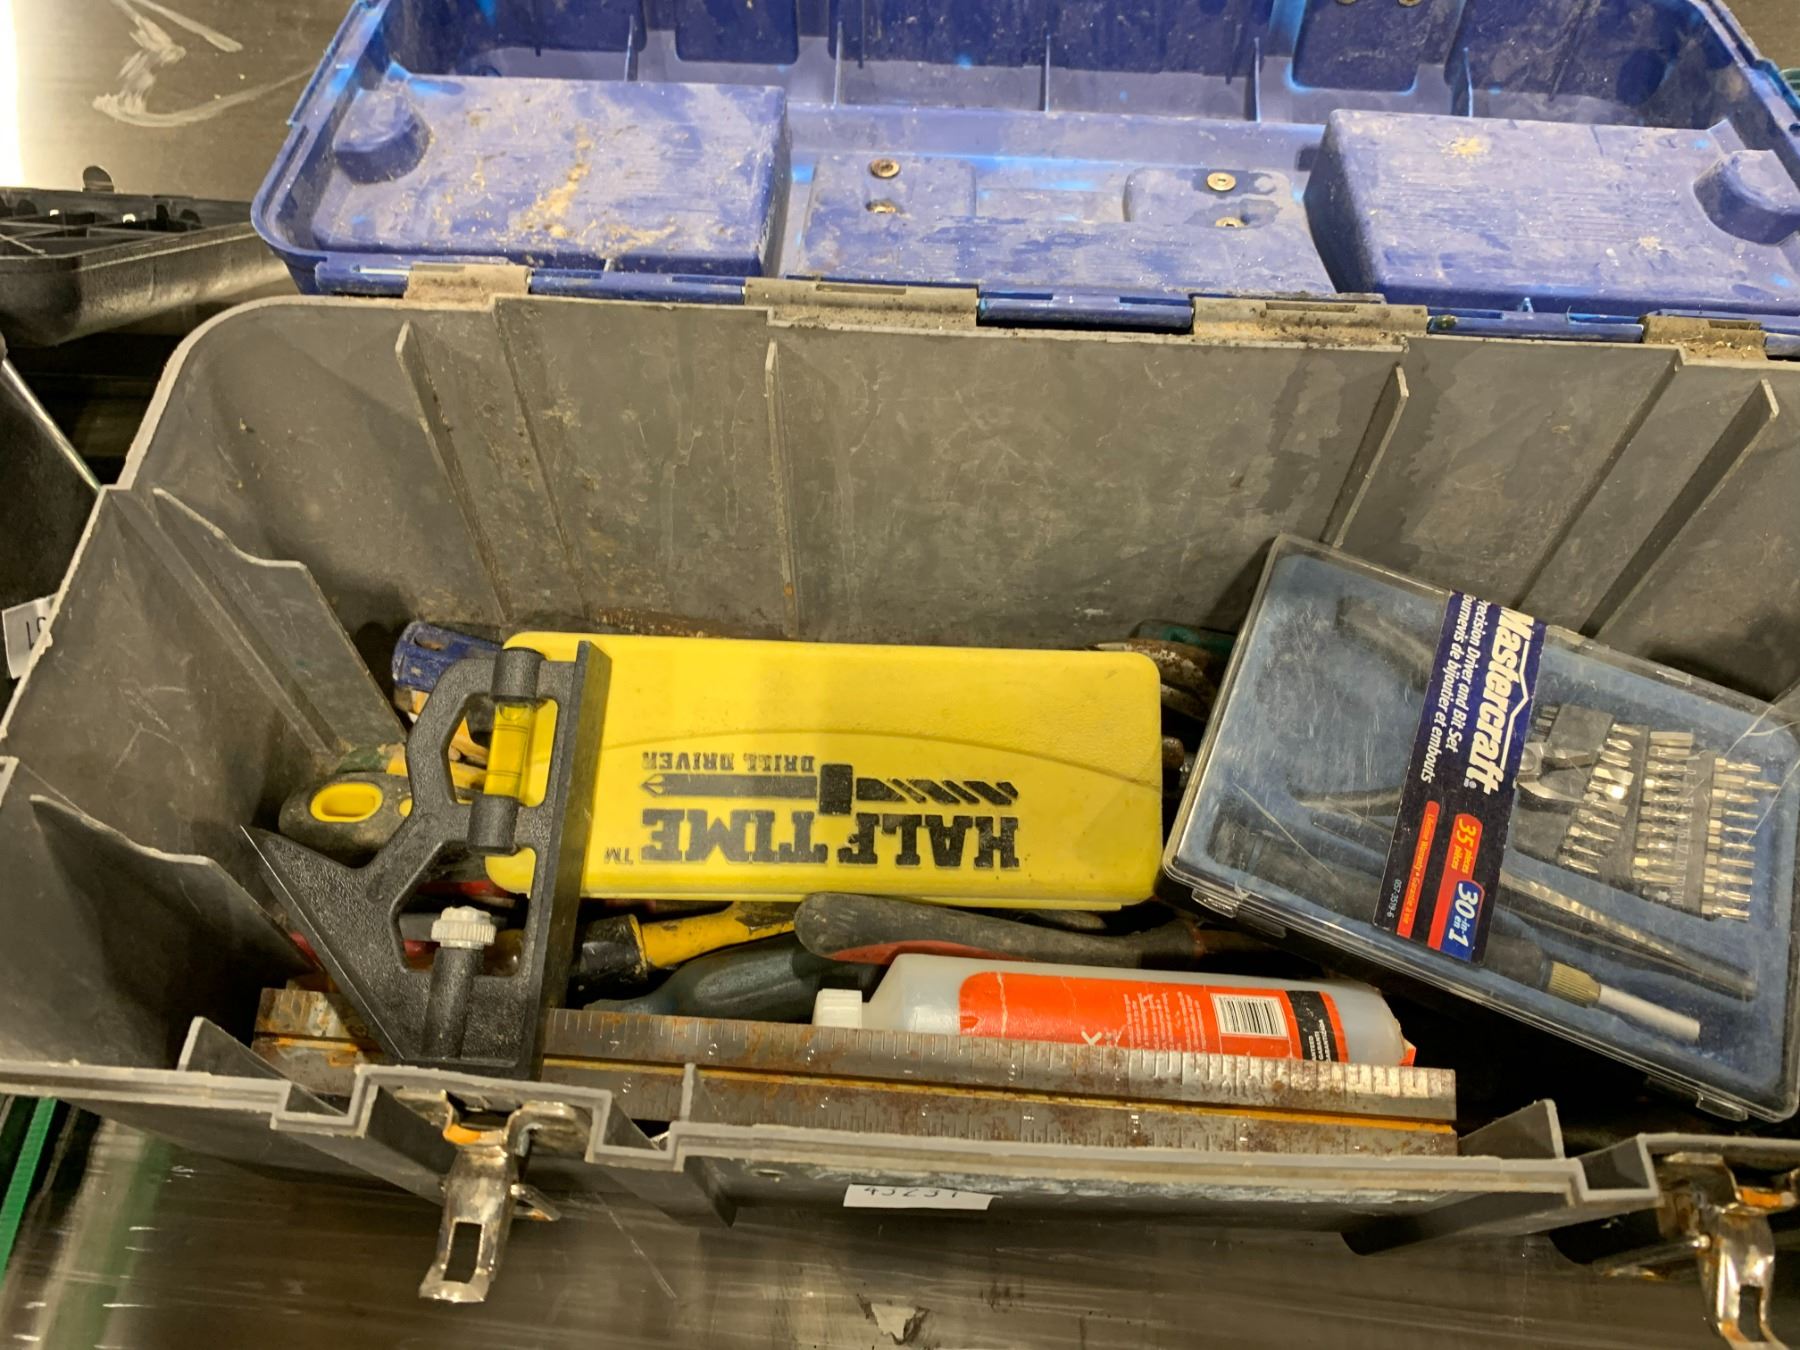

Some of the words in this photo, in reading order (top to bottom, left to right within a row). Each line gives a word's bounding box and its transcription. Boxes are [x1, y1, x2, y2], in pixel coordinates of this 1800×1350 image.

[1453, 594, 1476, 644] ournevis
[1449, 642, 1465, 660] de
[1461, 646, 1481, 684] Driver
[1438, 659, 1463, 713] bijoutier
[1455, 682, 1470, 711] and
[1466, 606, 1534, 795] Mastercraft
[1433, 711, 1447, 728] et
[1450, 708, 1468, 729] Bit
[1420, 726, 1442, 784] embouts
[1445, 727, 1463, 753] Set
[641, 751, 736, 771] DRIVER
[743, 754, 816, 772] DRILL
[639, 807, 829, 866] TIME
[836, 812, 1020, 870] HALF
[1456, 818, 1477, 849] 35
